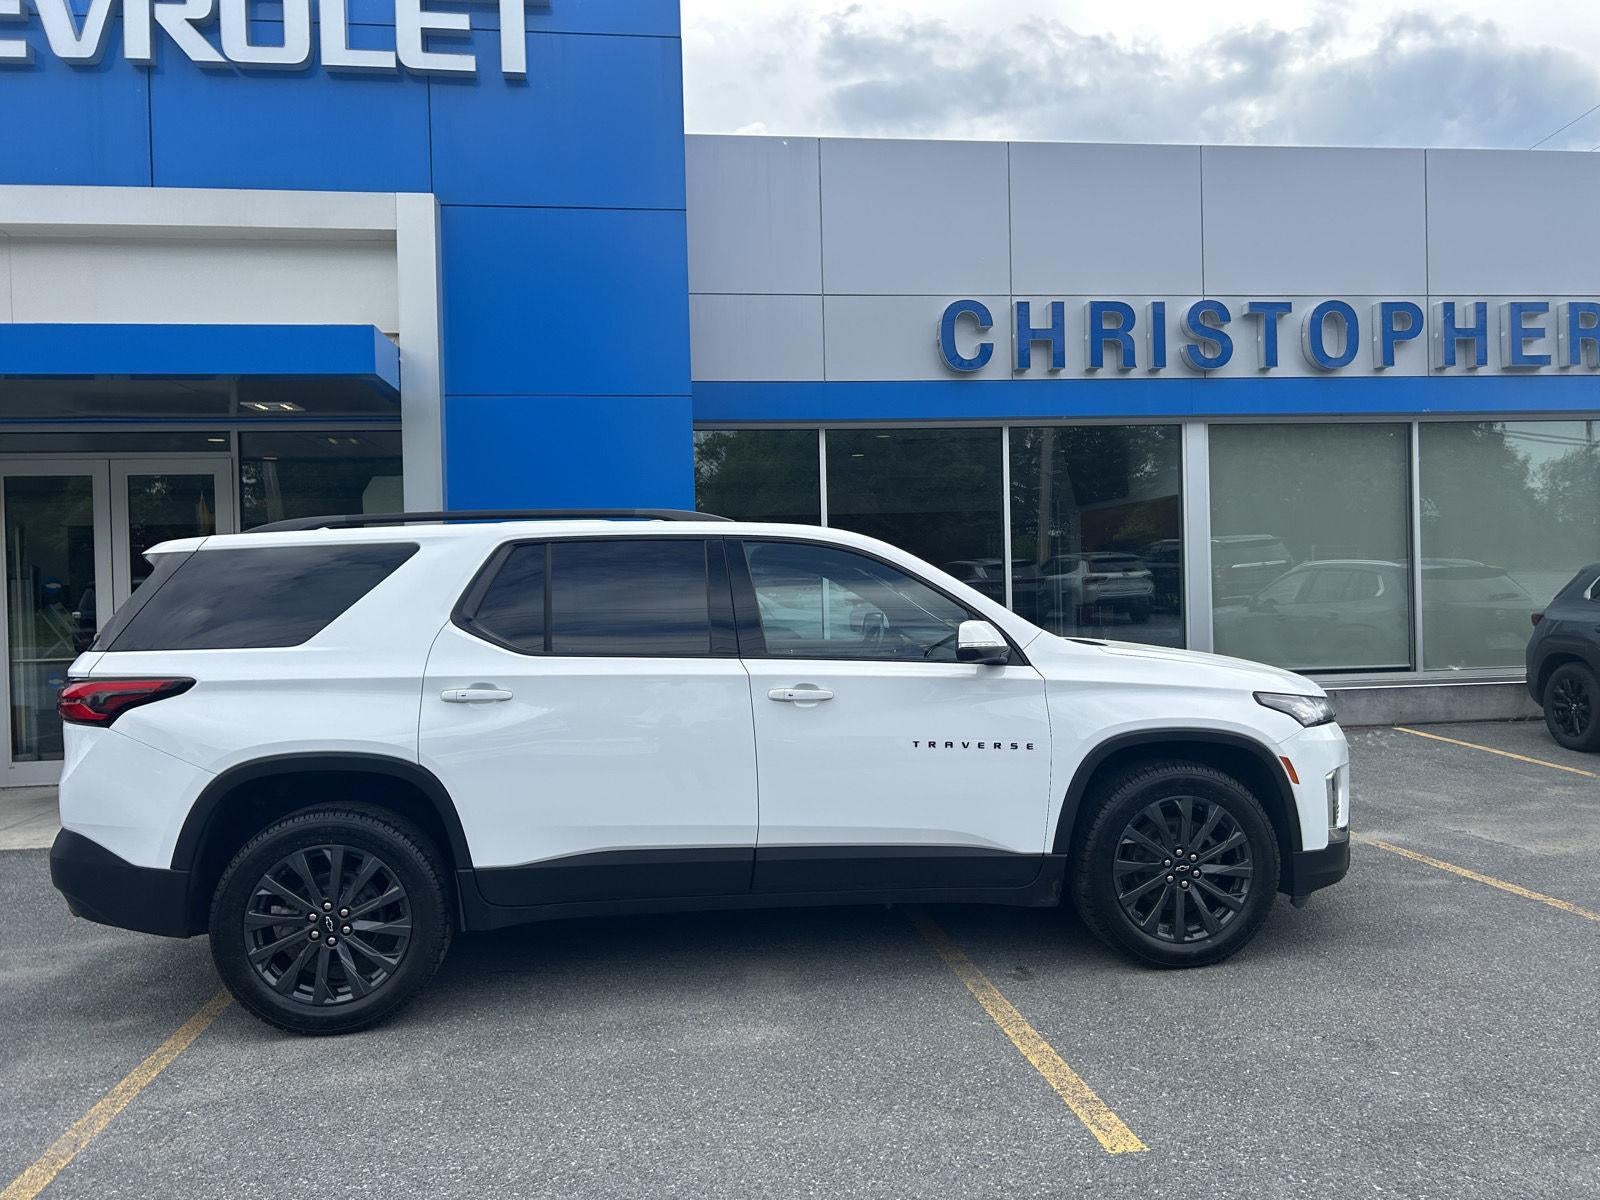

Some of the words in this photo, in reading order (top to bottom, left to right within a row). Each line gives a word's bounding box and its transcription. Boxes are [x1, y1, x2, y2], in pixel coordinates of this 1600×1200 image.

[0, 0, 527, 74] VROLET
[938, 299, 1600, 372] CHRISTOPHER
[912, 740, 1035, 750] TRAVERSE
